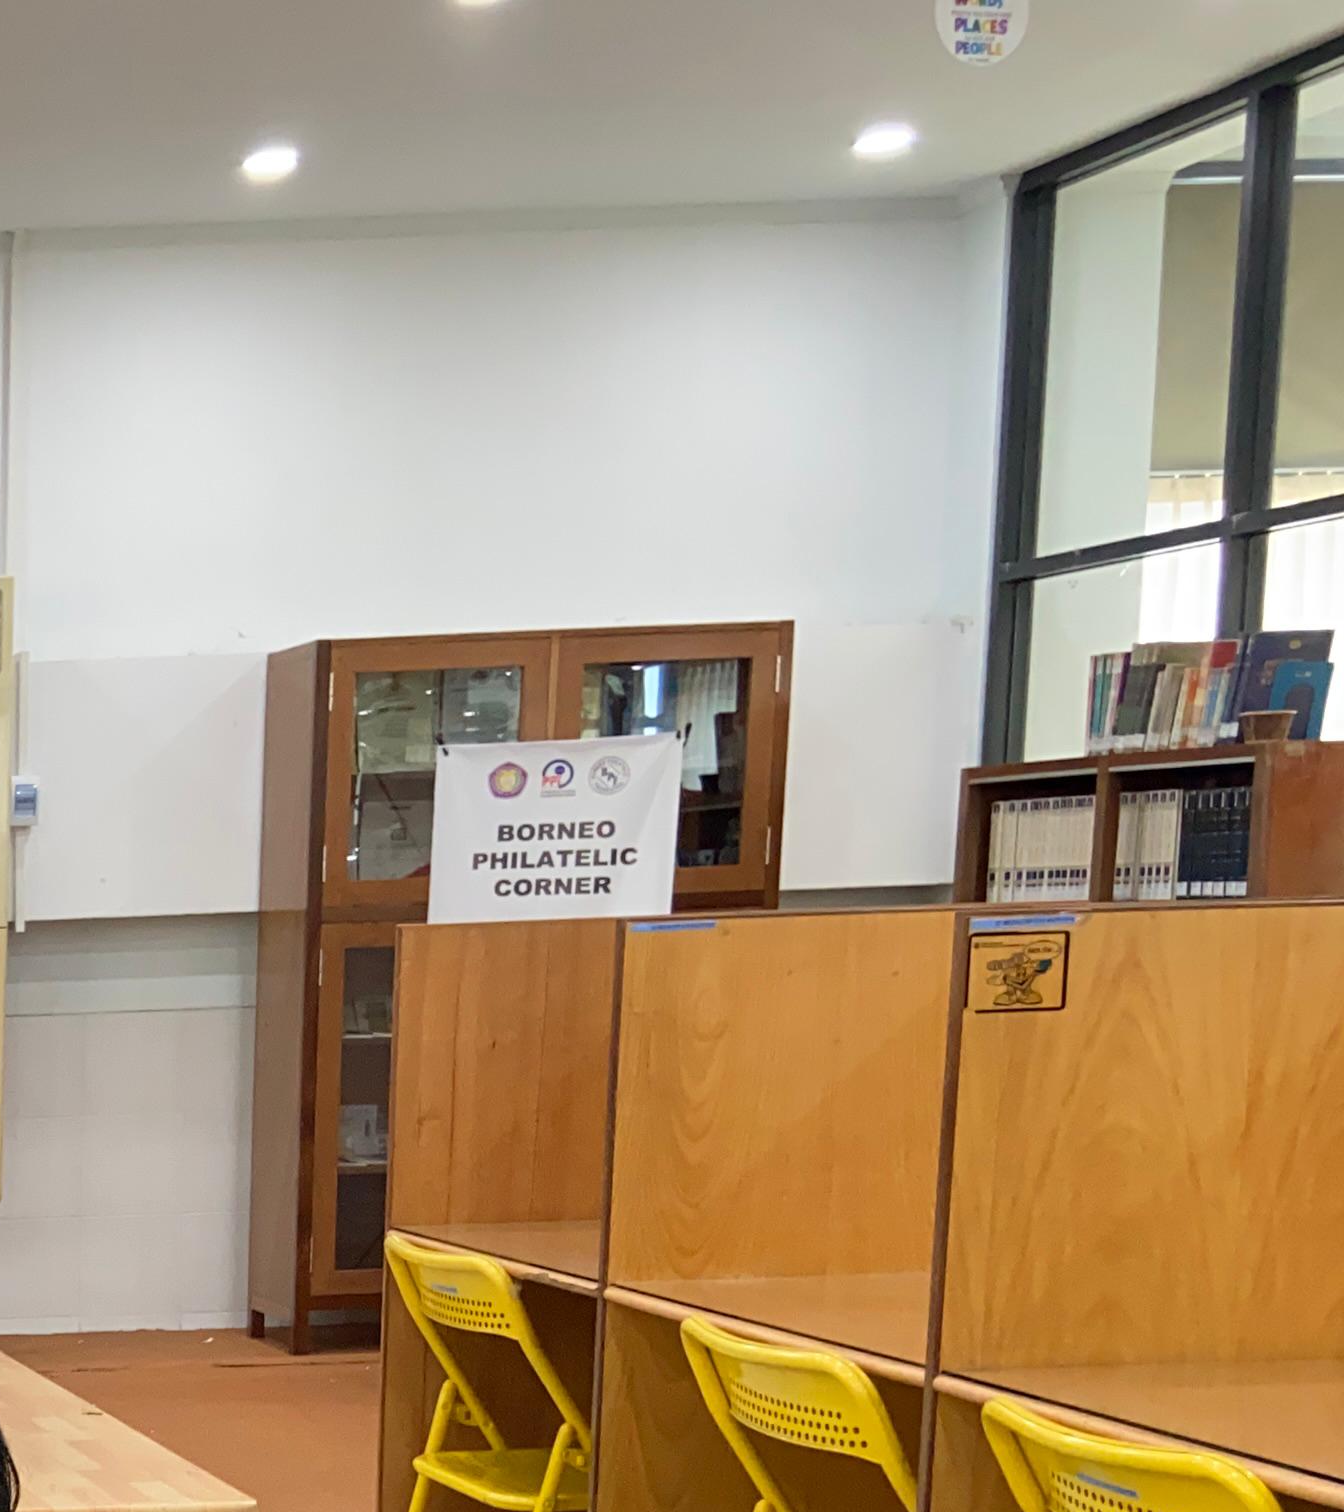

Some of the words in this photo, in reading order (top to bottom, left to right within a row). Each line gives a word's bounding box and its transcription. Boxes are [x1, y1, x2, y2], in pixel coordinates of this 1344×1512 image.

[955, 17, 1009, 35] PLACES
[955, 40, 1002, 56] PEOPLE
[497, 820, 615, 842] BORNEO
[472, 847, 638, 870] PHILATELIC
[494, 876, 611, 897] CORNER
